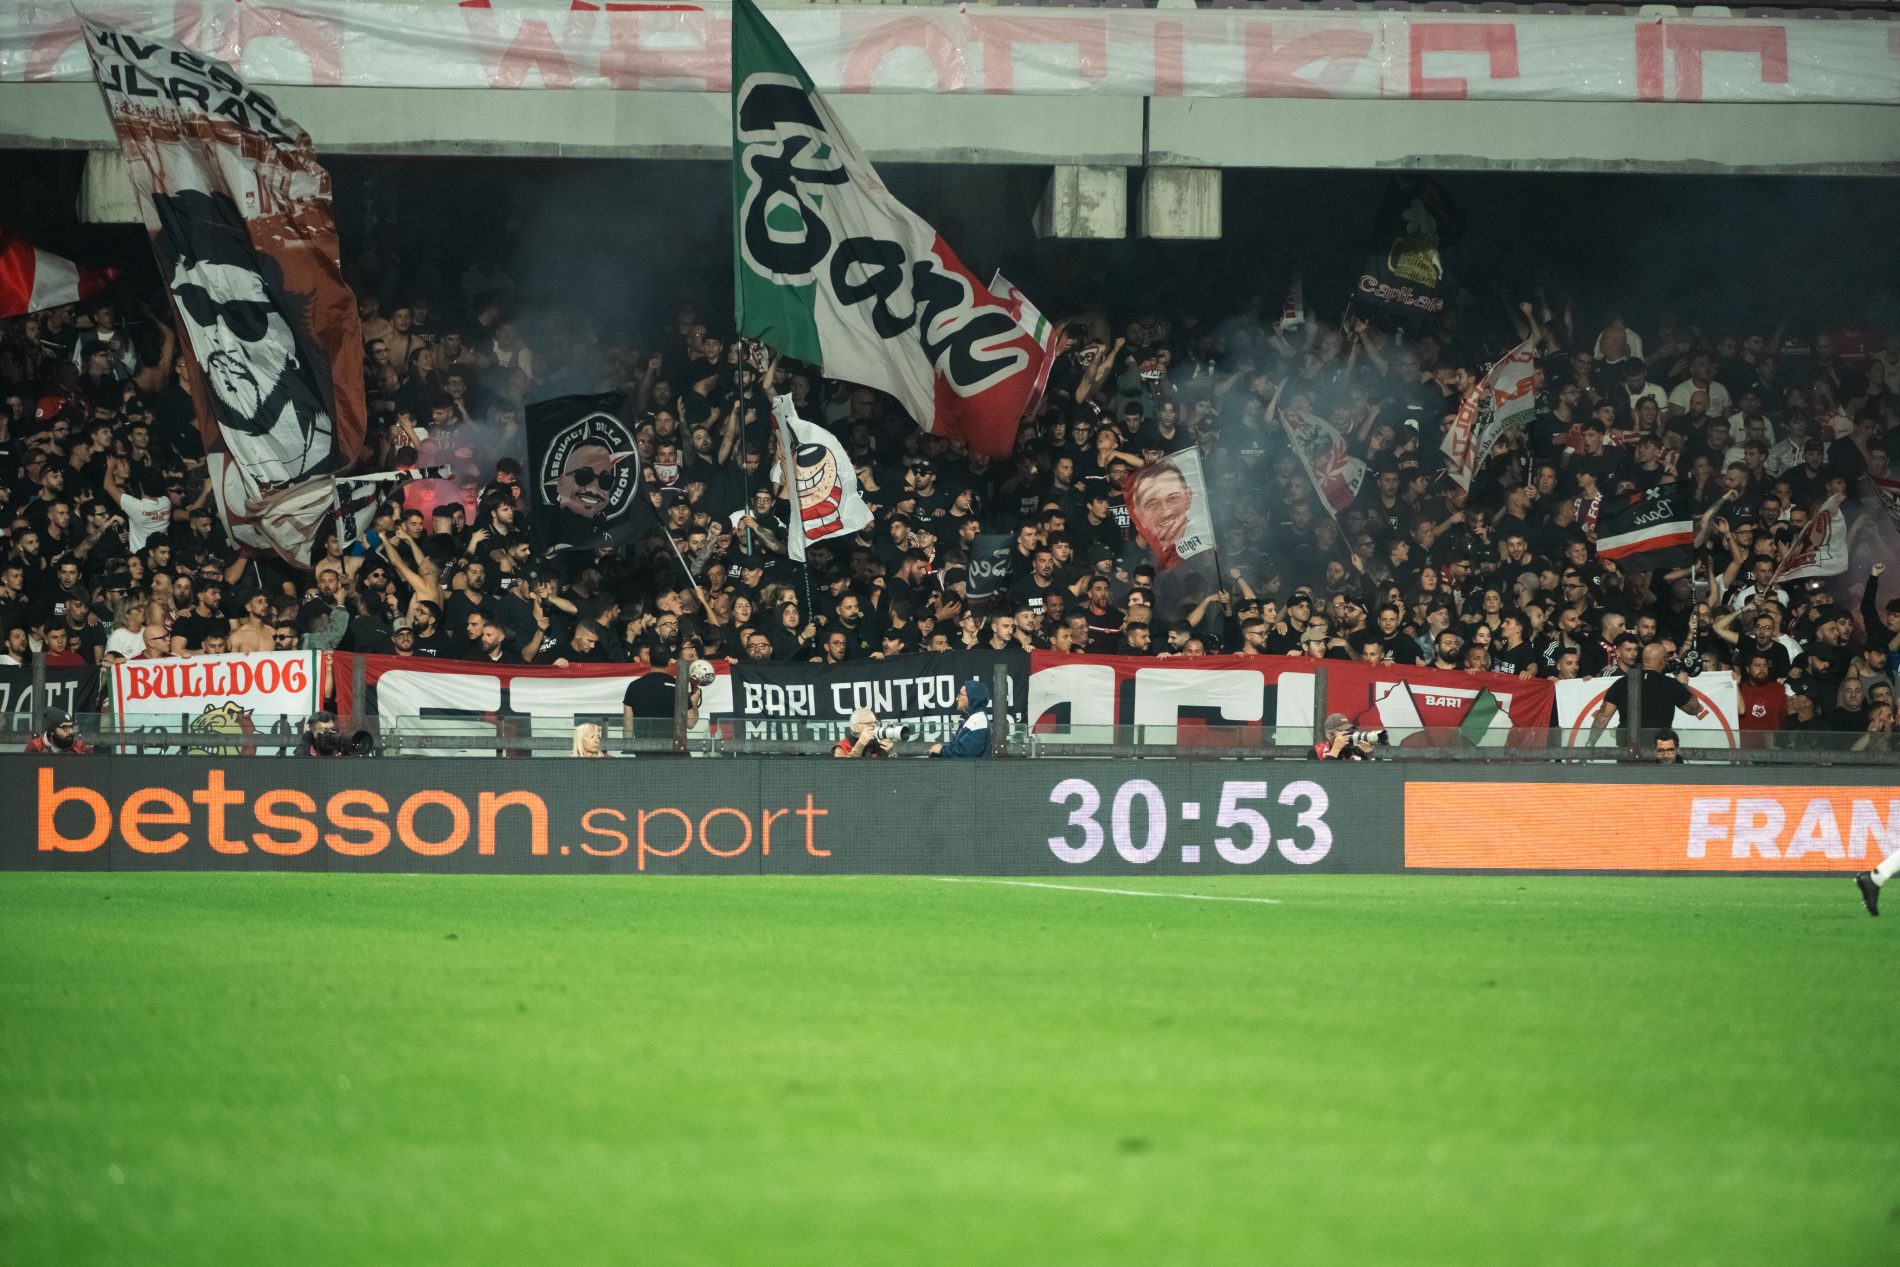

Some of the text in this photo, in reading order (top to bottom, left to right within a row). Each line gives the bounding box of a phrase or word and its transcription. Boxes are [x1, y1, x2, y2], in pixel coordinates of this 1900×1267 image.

[551, 429, 583, 478] SEGUACI
[610, 467, 630, 506] NORD
[127, 659, 307, 701] BULLDOG
[744, 681, 816, 716] BARI
[831, 675, 954, 715] CONTRO
[1425, 695, 1461, 708] BARI
[1047, 778, 1334, 866] 30:53
[1686, 797, 1900, 859] FRAN
